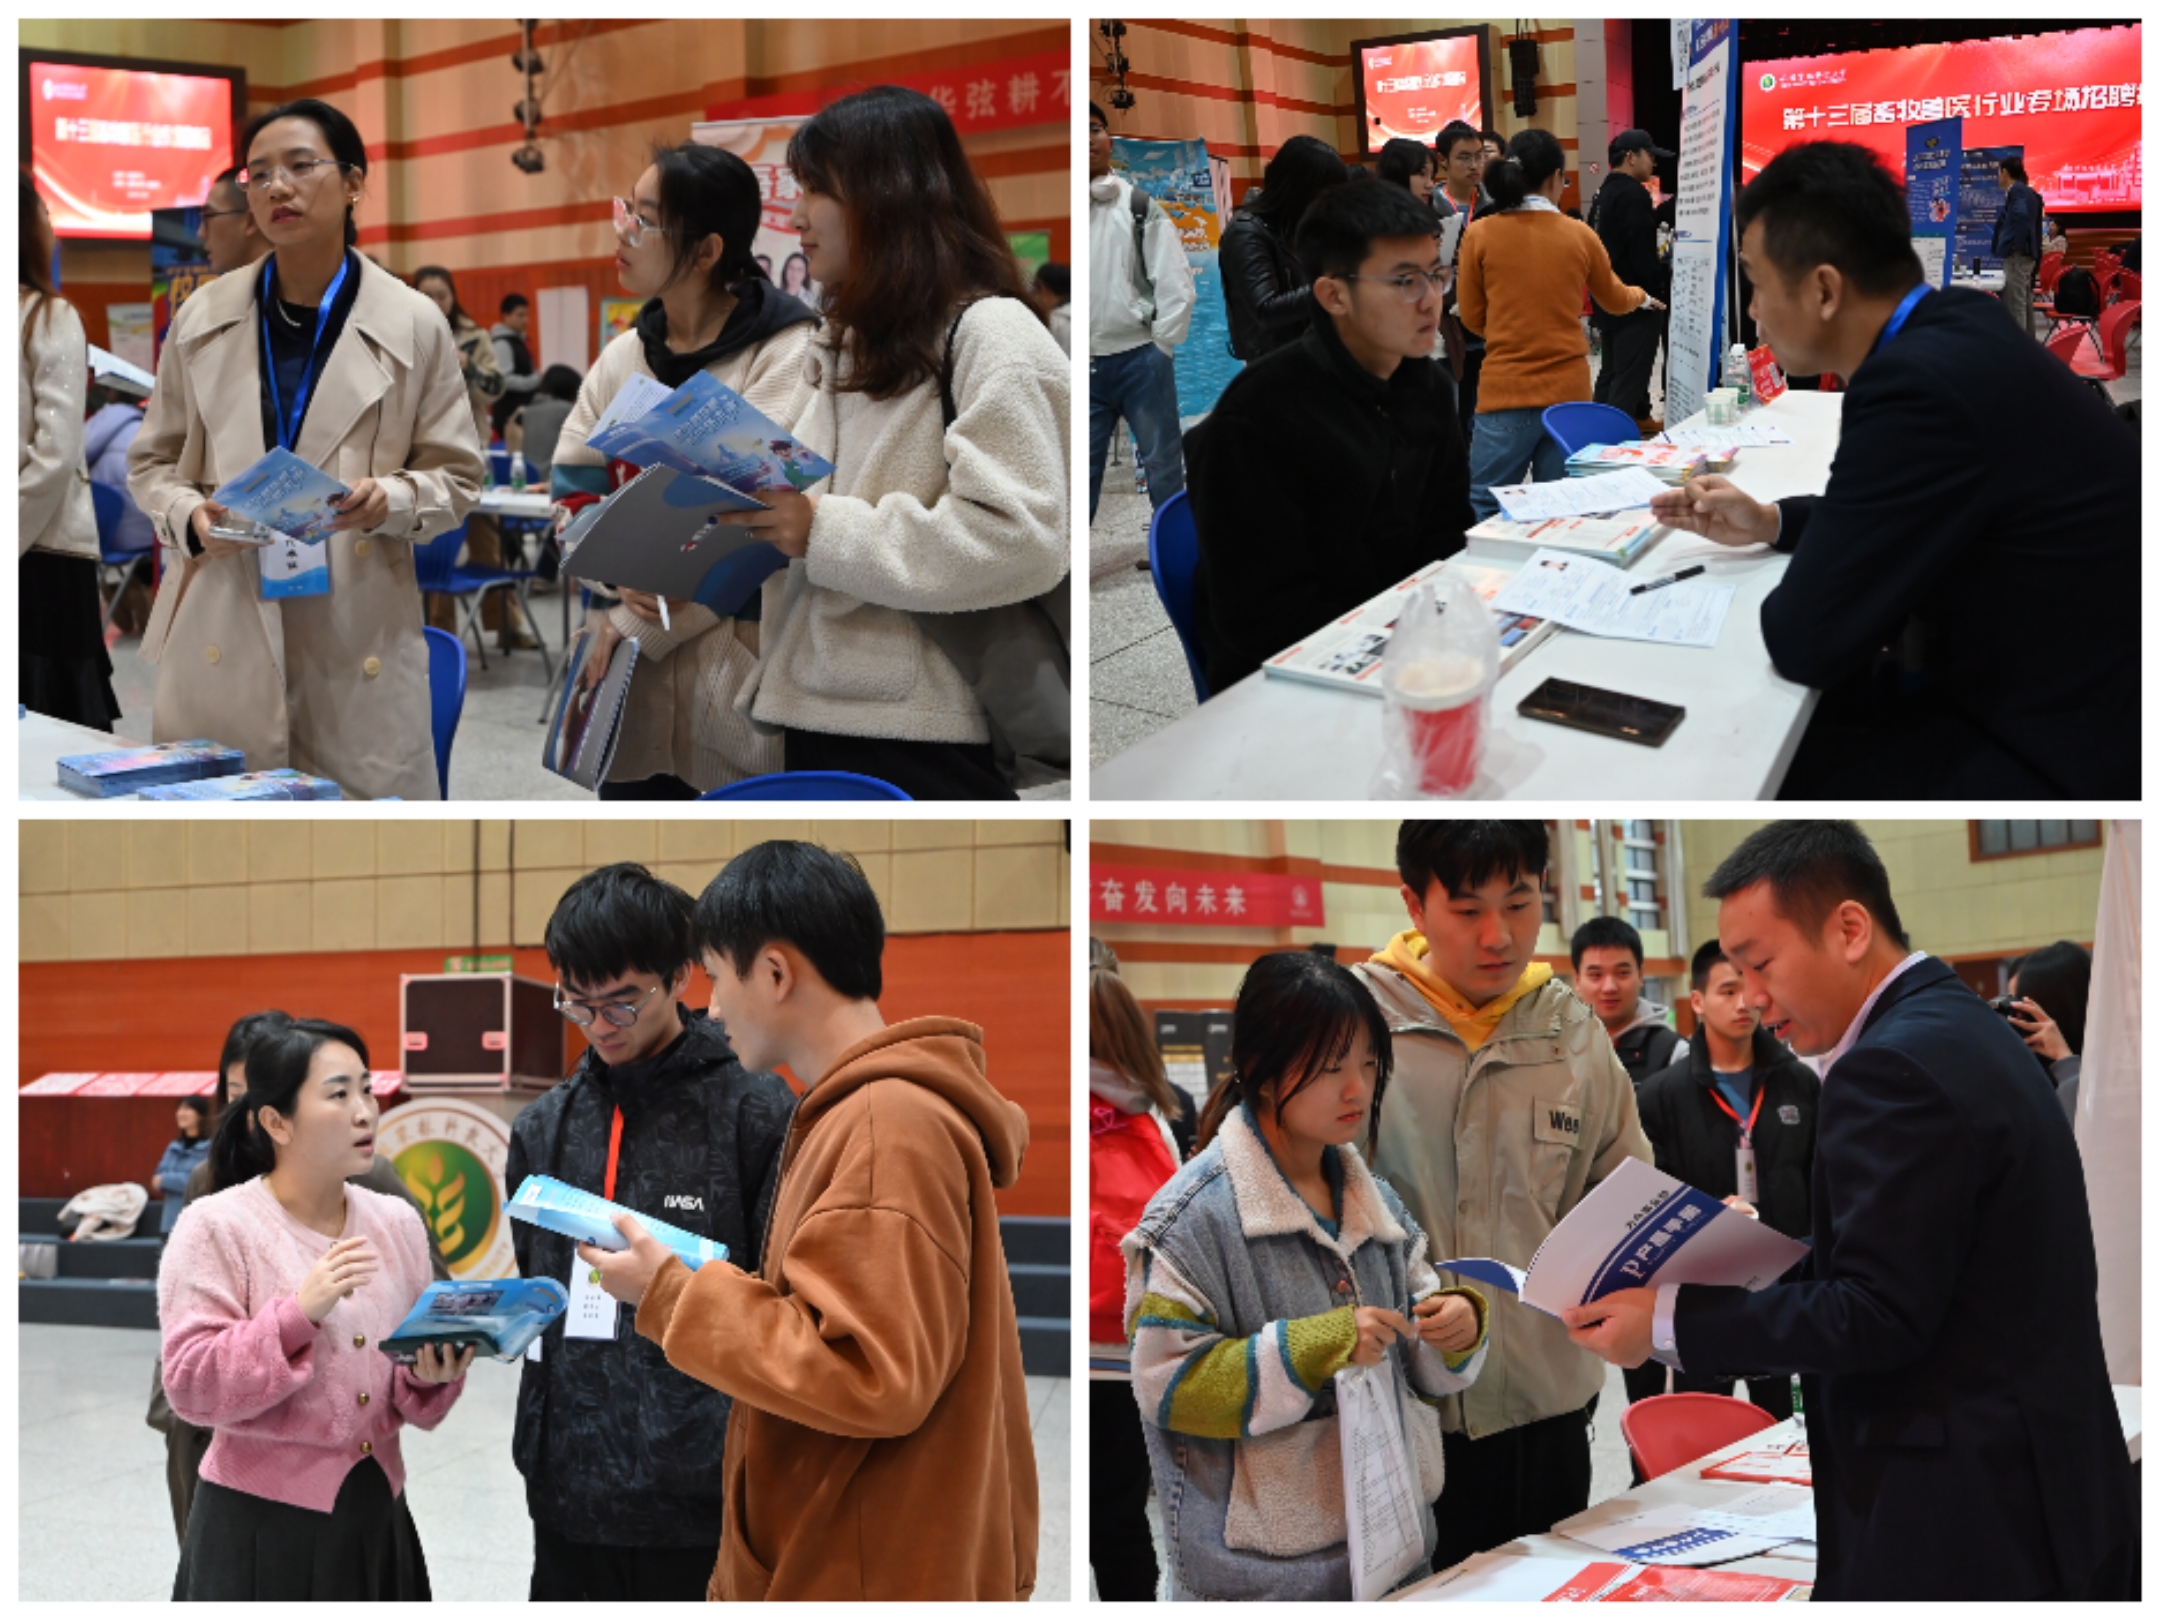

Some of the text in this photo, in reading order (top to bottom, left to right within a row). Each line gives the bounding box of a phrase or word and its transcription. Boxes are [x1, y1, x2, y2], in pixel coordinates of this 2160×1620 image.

[1100, 876, 1247, 916] 奋发向未来
[663, 1194, 704, 1212] NASA
